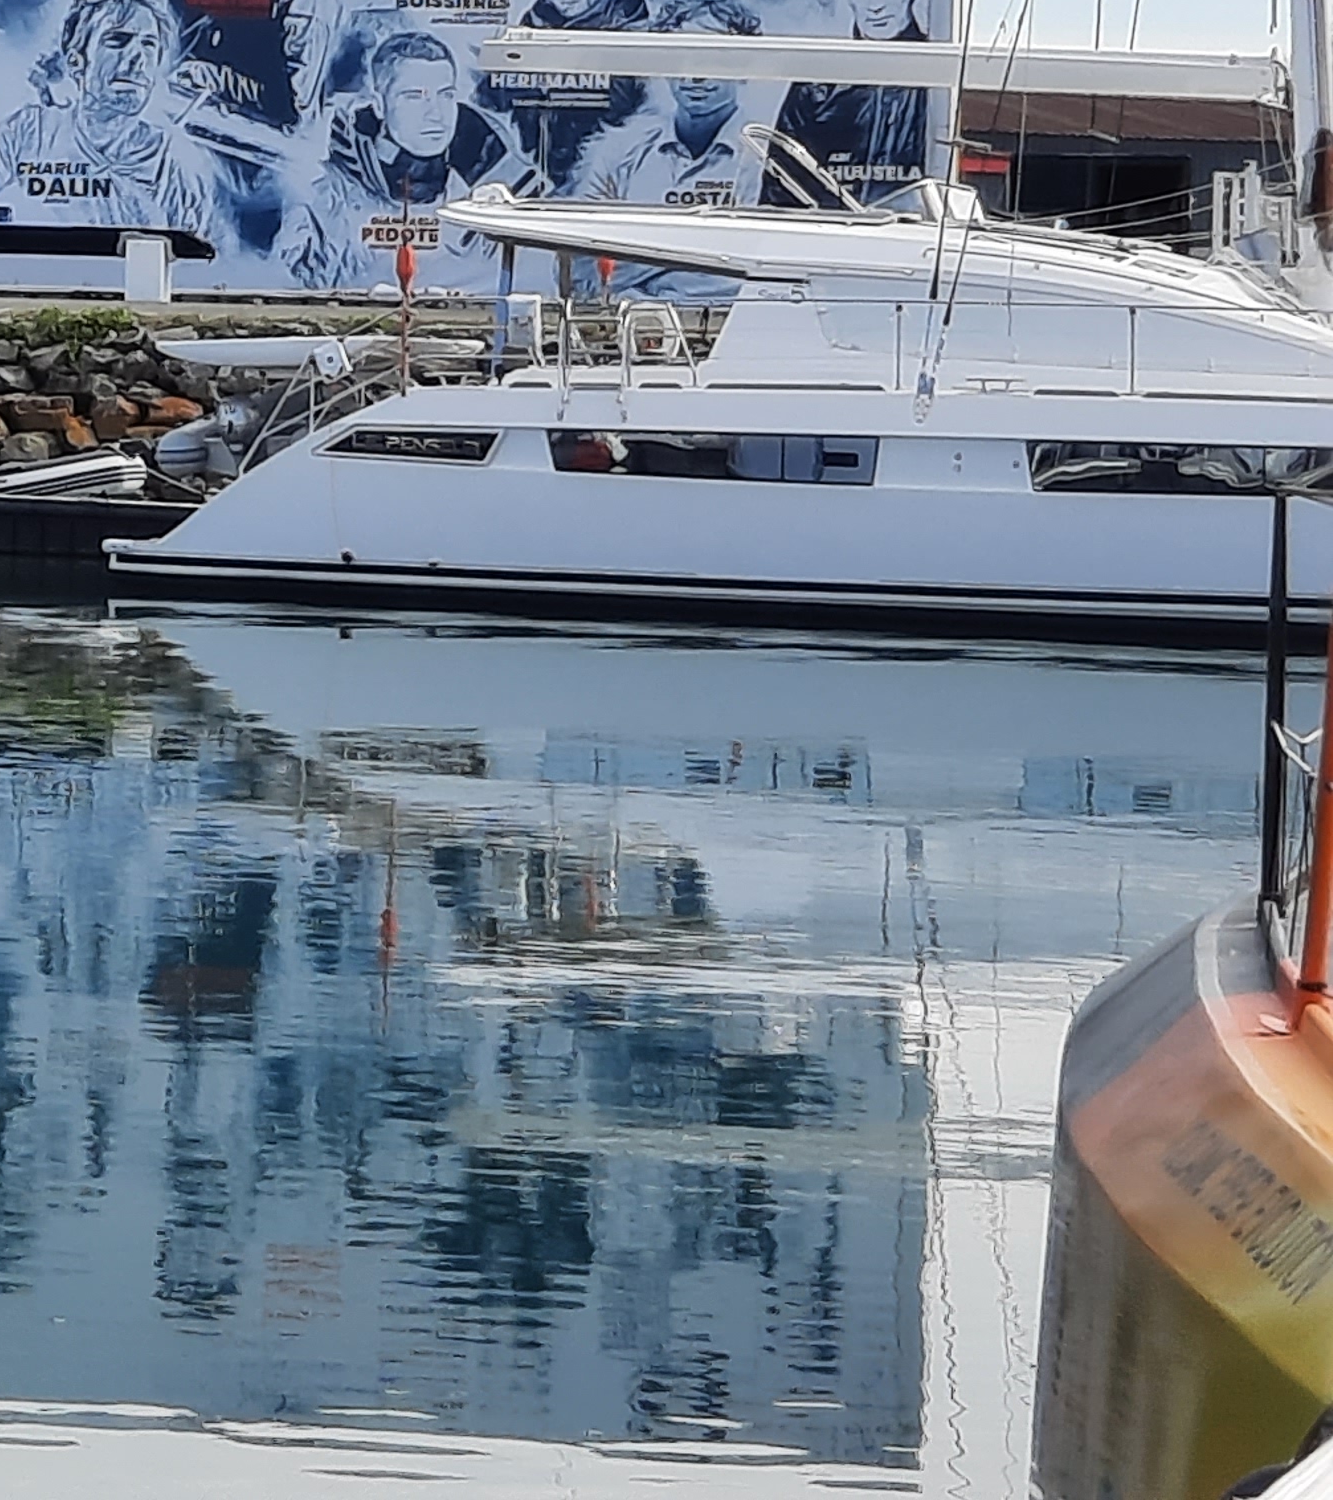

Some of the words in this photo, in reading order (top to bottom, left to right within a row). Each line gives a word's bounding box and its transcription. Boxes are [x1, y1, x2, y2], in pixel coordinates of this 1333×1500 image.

[27, 177, 112, 198] DALIN
[665, 191, 736, 207] COSTA
[361, 227, 439, 243] PEDOTE
